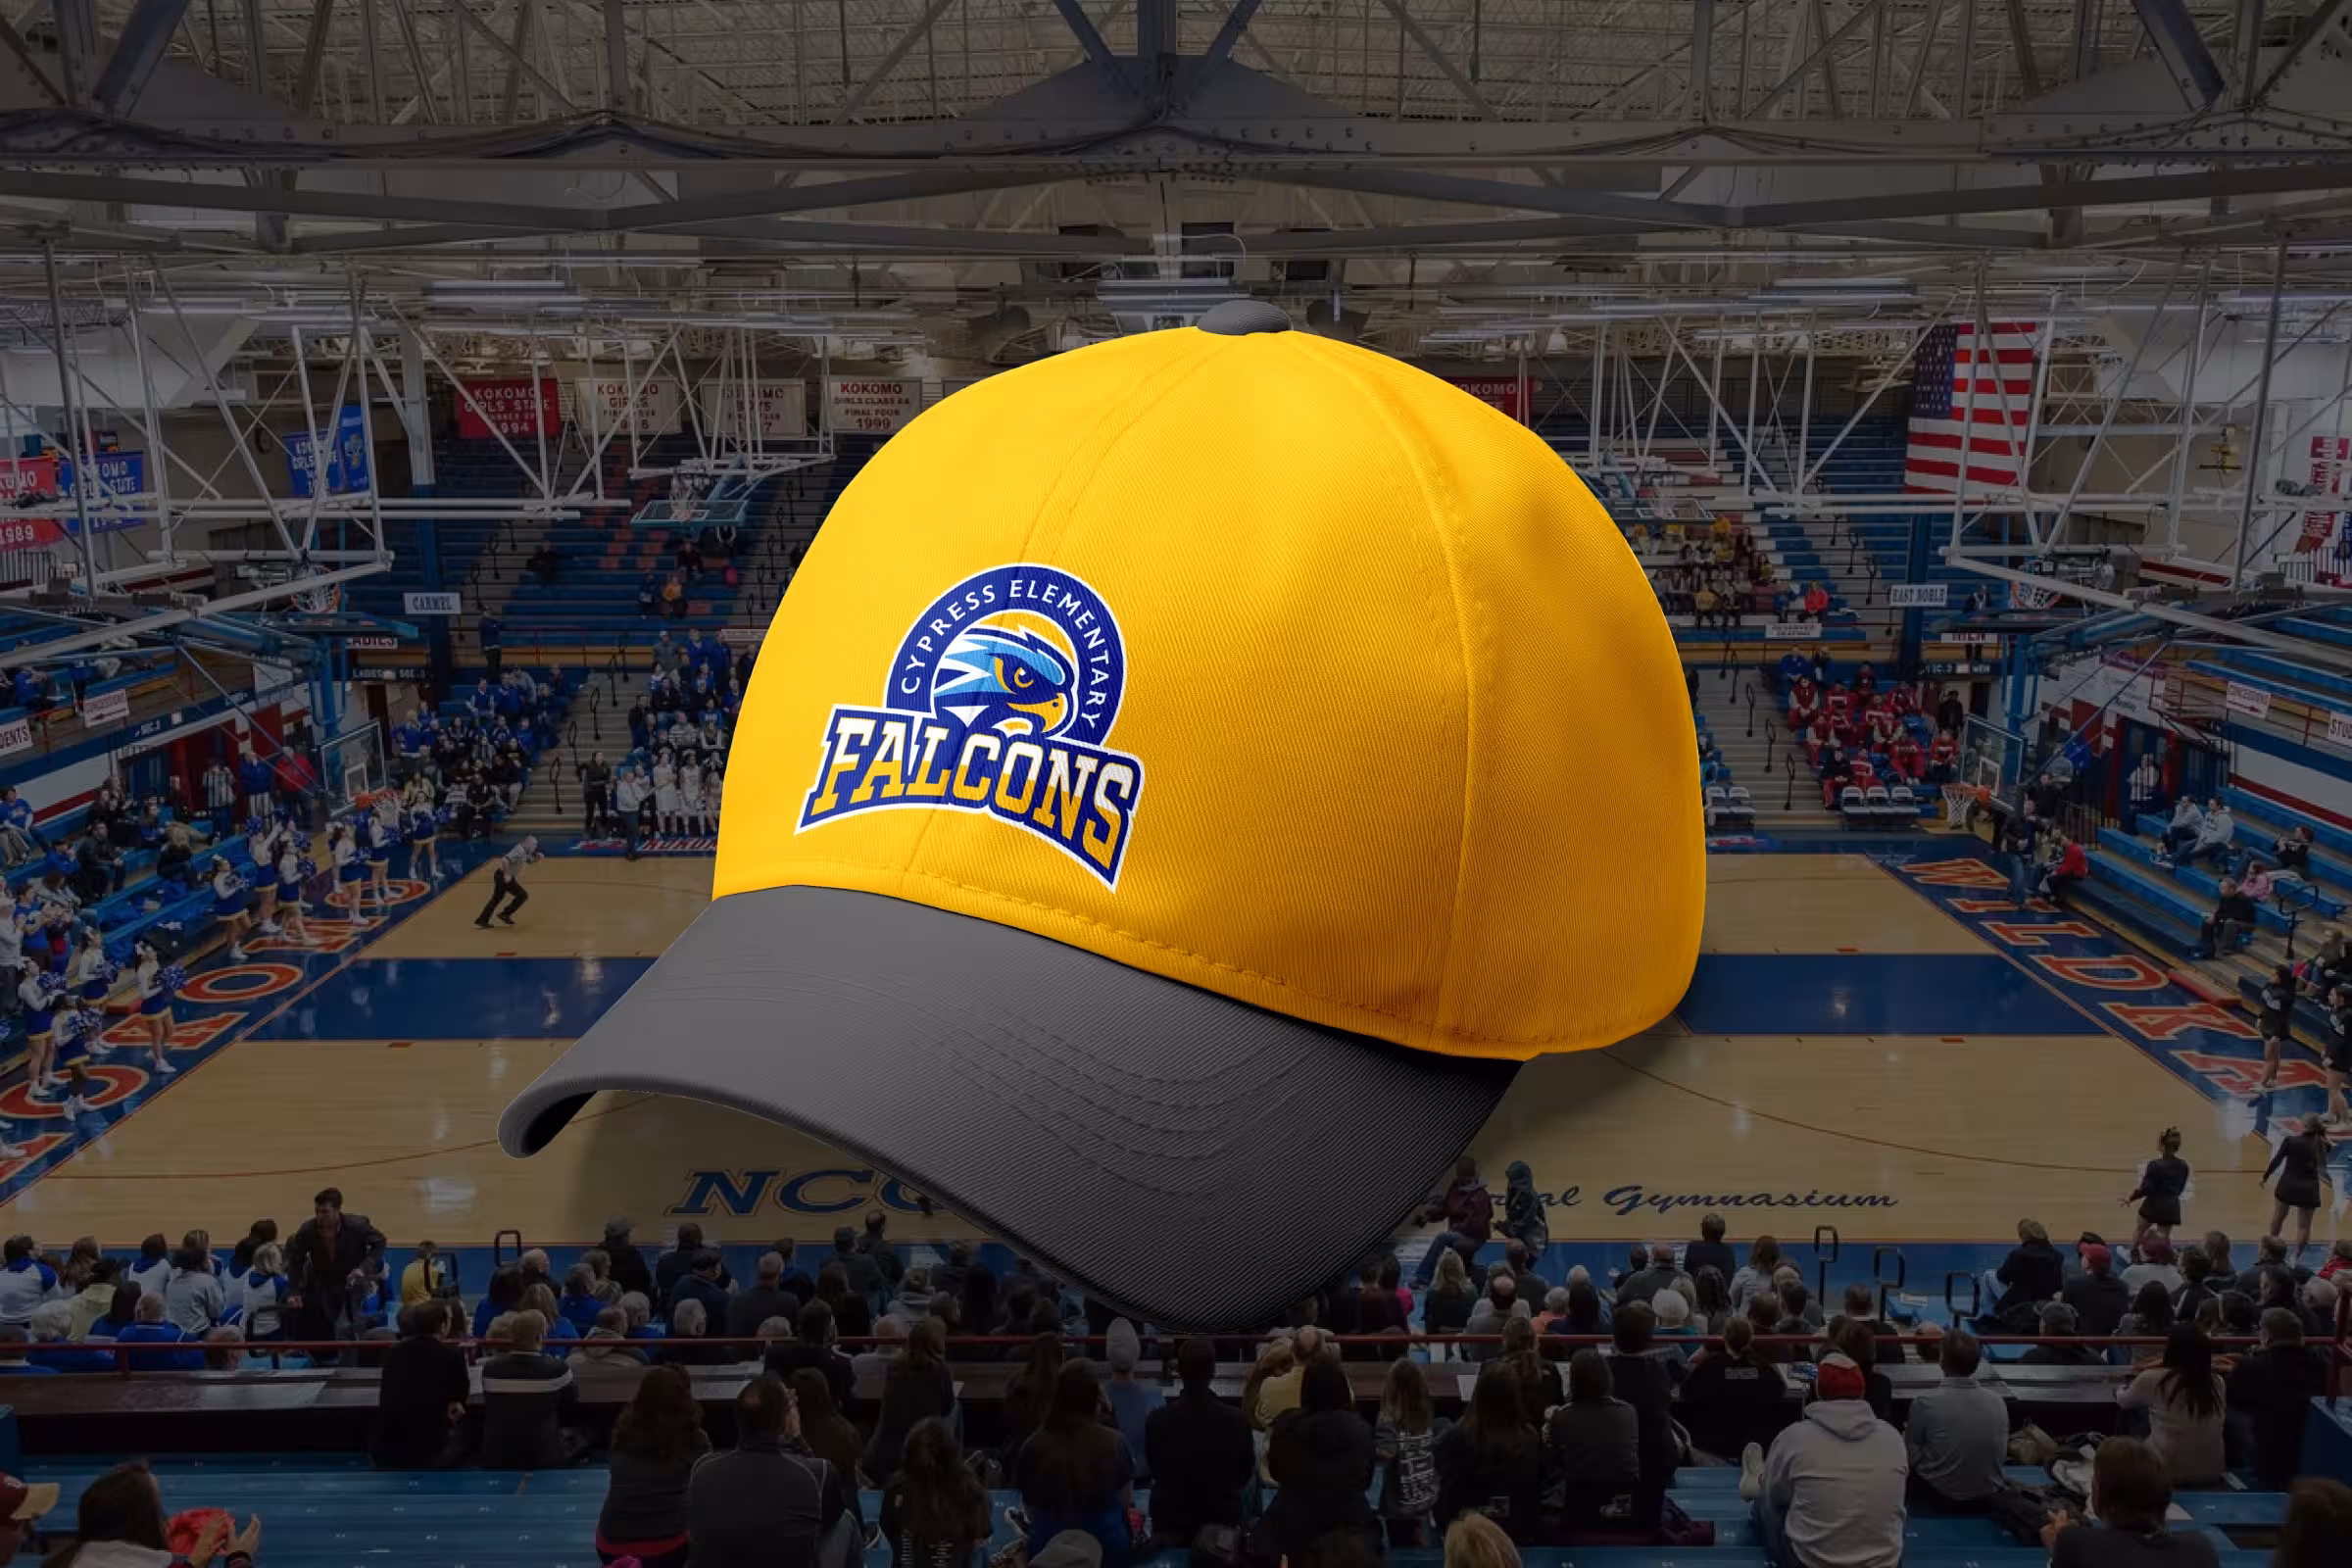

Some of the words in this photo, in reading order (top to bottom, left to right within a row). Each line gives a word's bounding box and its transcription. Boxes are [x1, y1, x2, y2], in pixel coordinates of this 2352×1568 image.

[841, 383, 903, 395] KOKOMO
[1456, 383, 1516, 395] OKOMO
[412, 595, 454, 612] CARMEL
[1892, 588, 1913, 604] EAST
[901, 584, 996, 694] CYPRESS
[1009, 579, 1110, 729] ELEMENTARY
[809, 716, 1135, 871] FALCONS
[1603, 1185, 1898, 1216] Gymnasium
